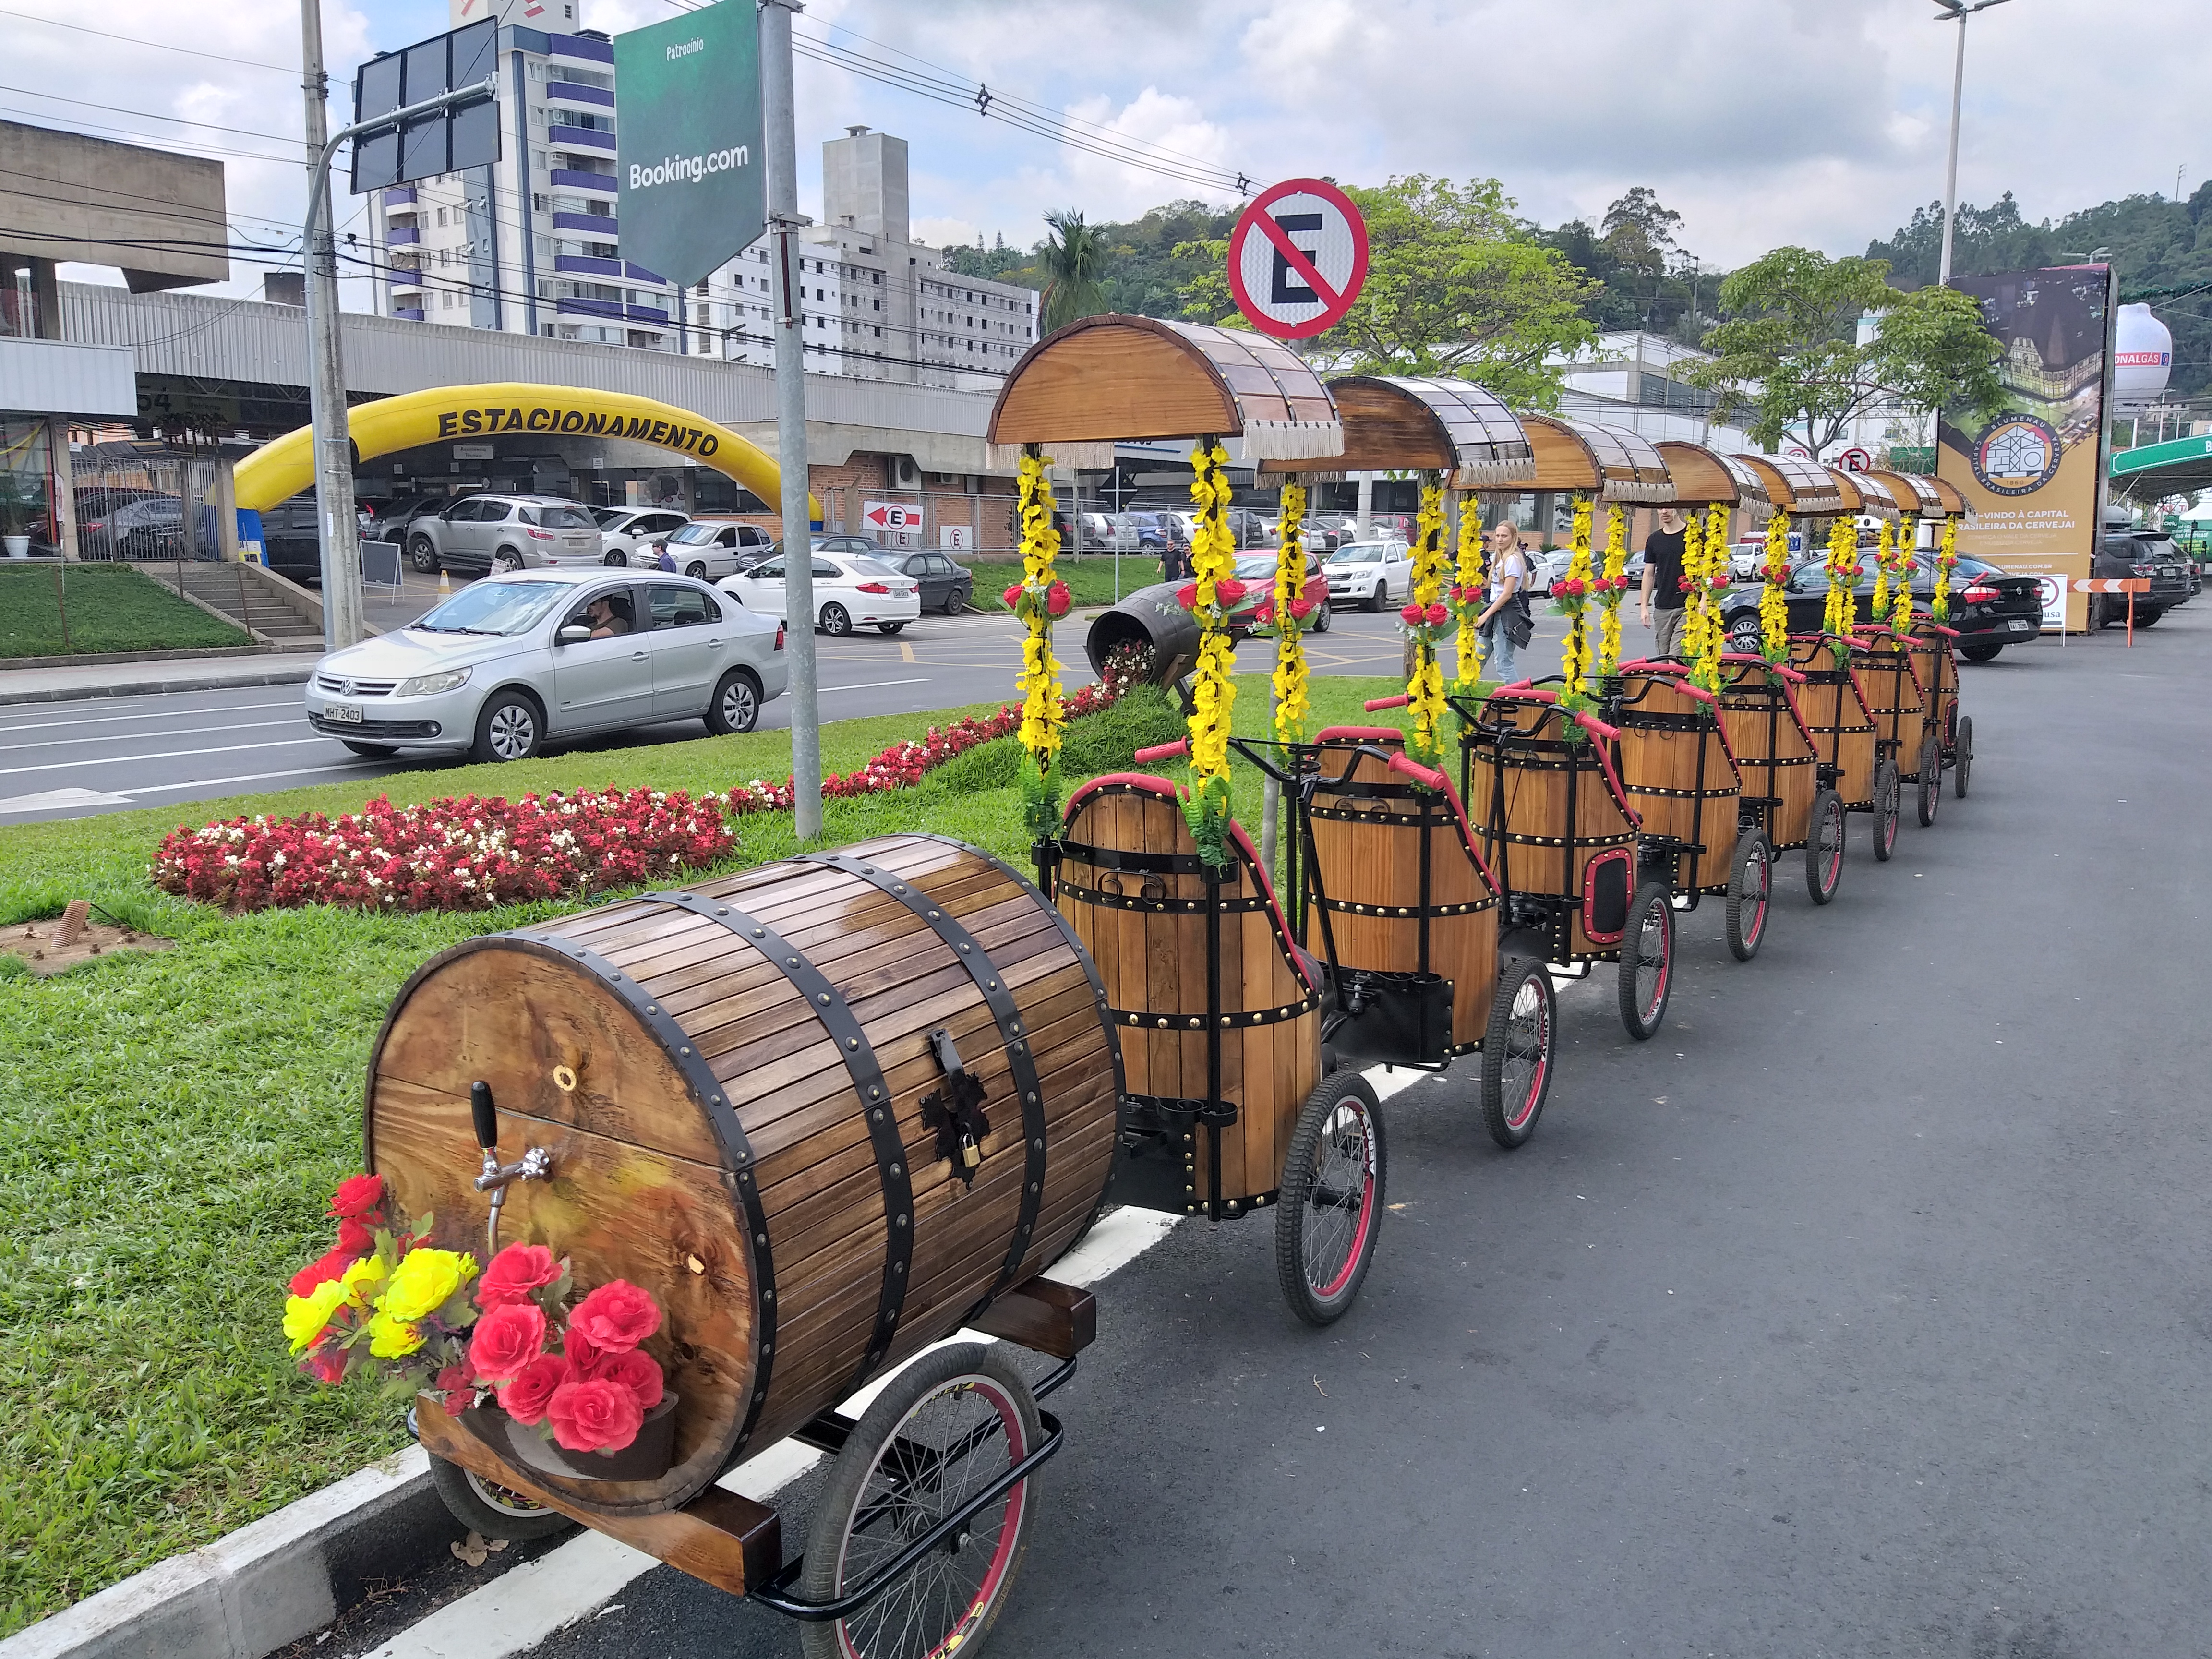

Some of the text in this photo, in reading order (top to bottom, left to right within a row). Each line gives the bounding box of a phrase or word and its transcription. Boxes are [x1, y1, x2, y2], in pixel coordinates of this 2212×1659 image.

[666, 37, 704, 61] Patrocínio
[630, 145, 748, 189] Booking.com
[1271, 213, 1323, 304] E
[438, 408, 719, 456] ESTACIONAMENTO
[1991, 416, 2045, 430] BLUMENAU
[1973, 436, 2060, 494] CAPITAL BRASILEIRA DA CERVEJA
[890, 511, 902, 525] E
[2018, 509, 2025, 518] À
[1956, 522, 2007, 530] RASILEIRA
